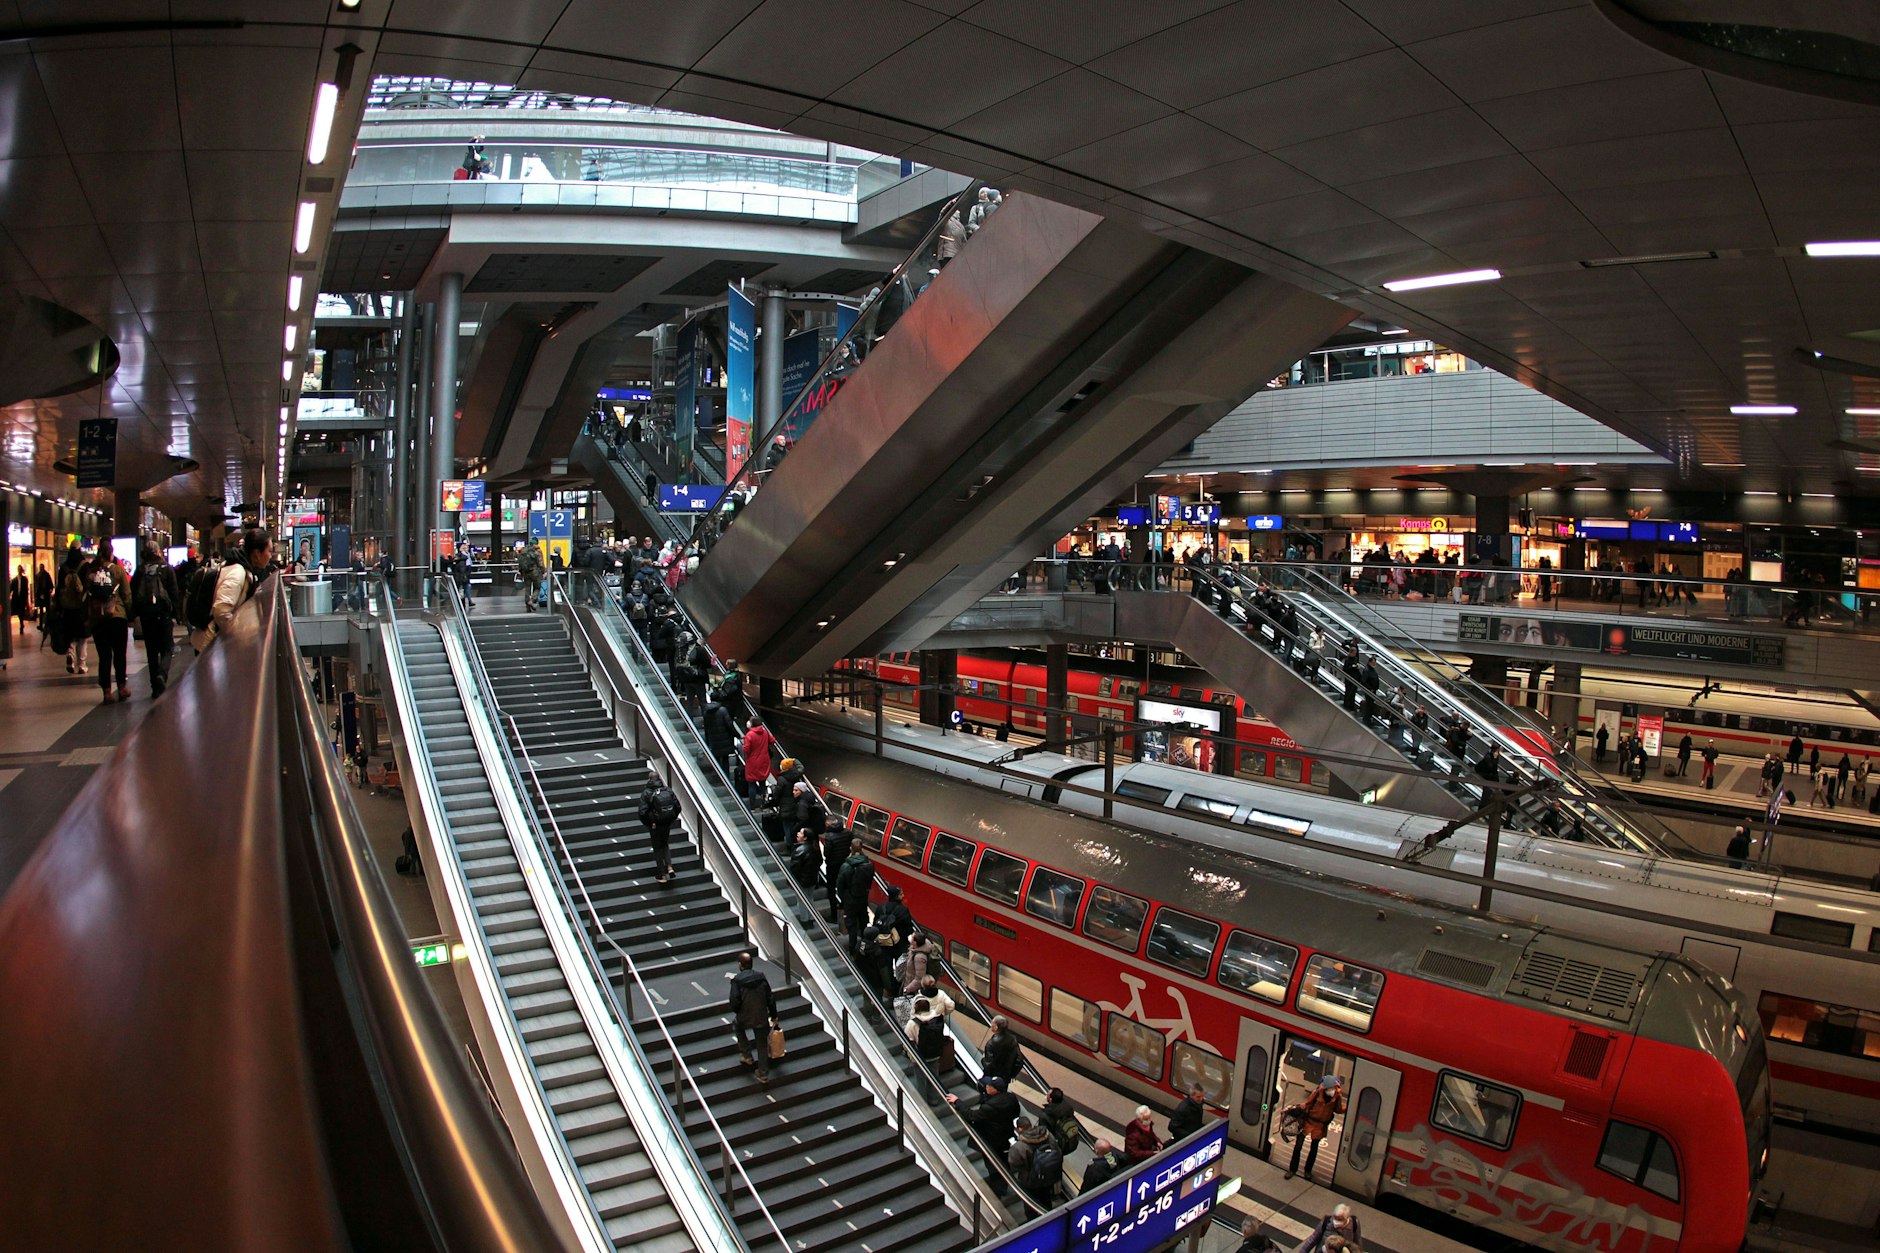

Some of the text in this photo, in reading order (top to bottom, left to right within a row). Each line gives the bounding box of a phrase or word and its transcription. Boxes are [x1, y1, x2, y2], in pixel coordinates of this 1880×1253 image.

[83, 425, 100, 438] 1-2
[672, 485, 689, 496] 1-4
[541, 513, 565, 527] 1-2
[1400, 518, 1431, 531] Kamps
[1477, 535, 1492, 545] 7-8
[1634, 629, 1749, 649] WELTFLUCHT UND MODERNE
[951, 710, 960, 723] C
[1172, 708, 1185, 719] sky
[1270, 737, 1296, 749] REGIO
[1194, 1168, 1213, 1188] U S
[1091, 1190, 1174, 1251] 1-2 und 5-16
